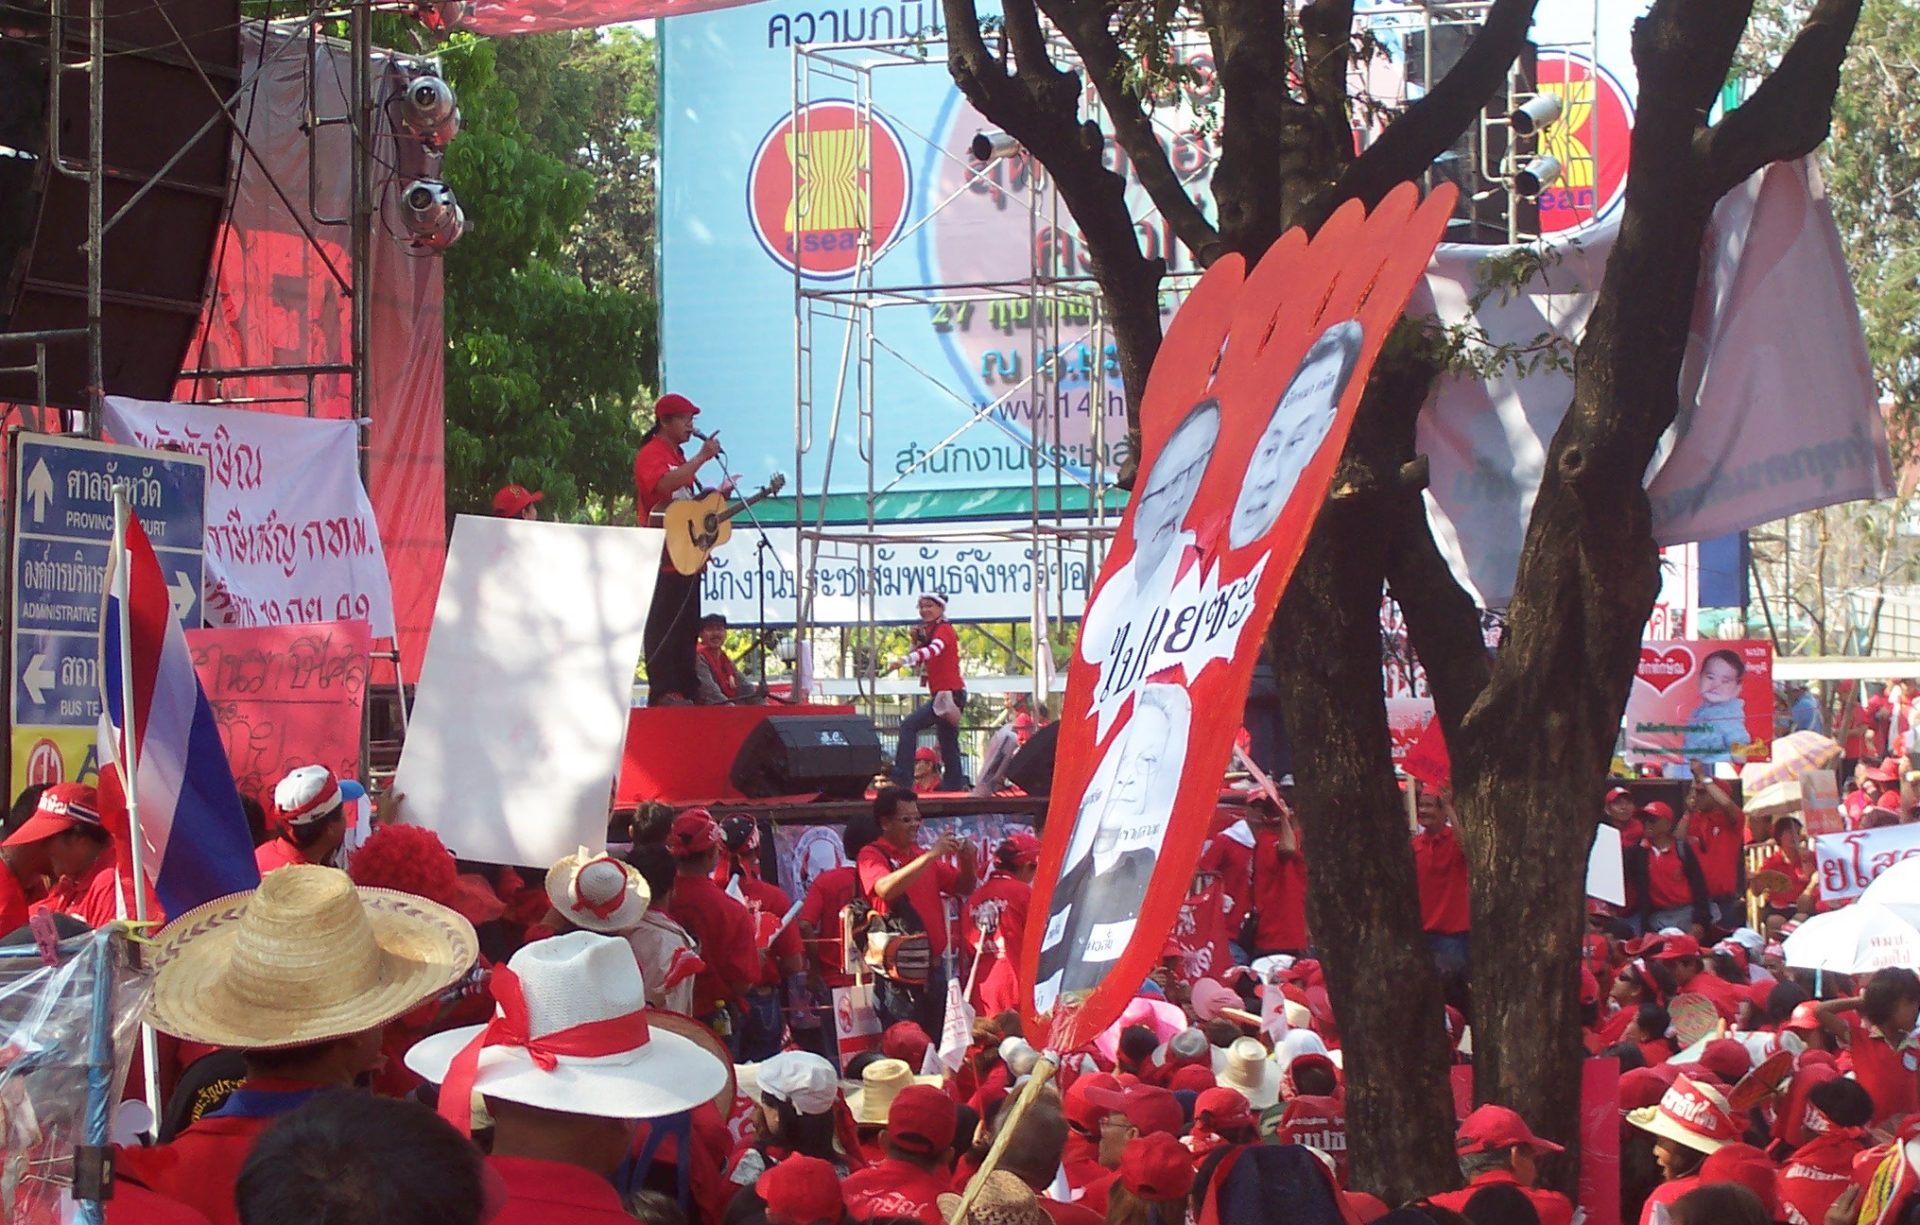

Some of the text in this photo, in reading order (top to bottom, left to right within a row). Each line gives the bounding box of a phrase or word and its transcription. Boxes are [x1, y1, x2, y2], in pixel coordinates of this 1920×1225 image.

[785, 229, 864, 255] asea
[66, 511, 167, 537] PROVINC OURT
[22, 602, 97, 623] ADMINISTRATIVE
[61, 656, 98, 687] สถา
[60, 700, 83, 716] BUS
